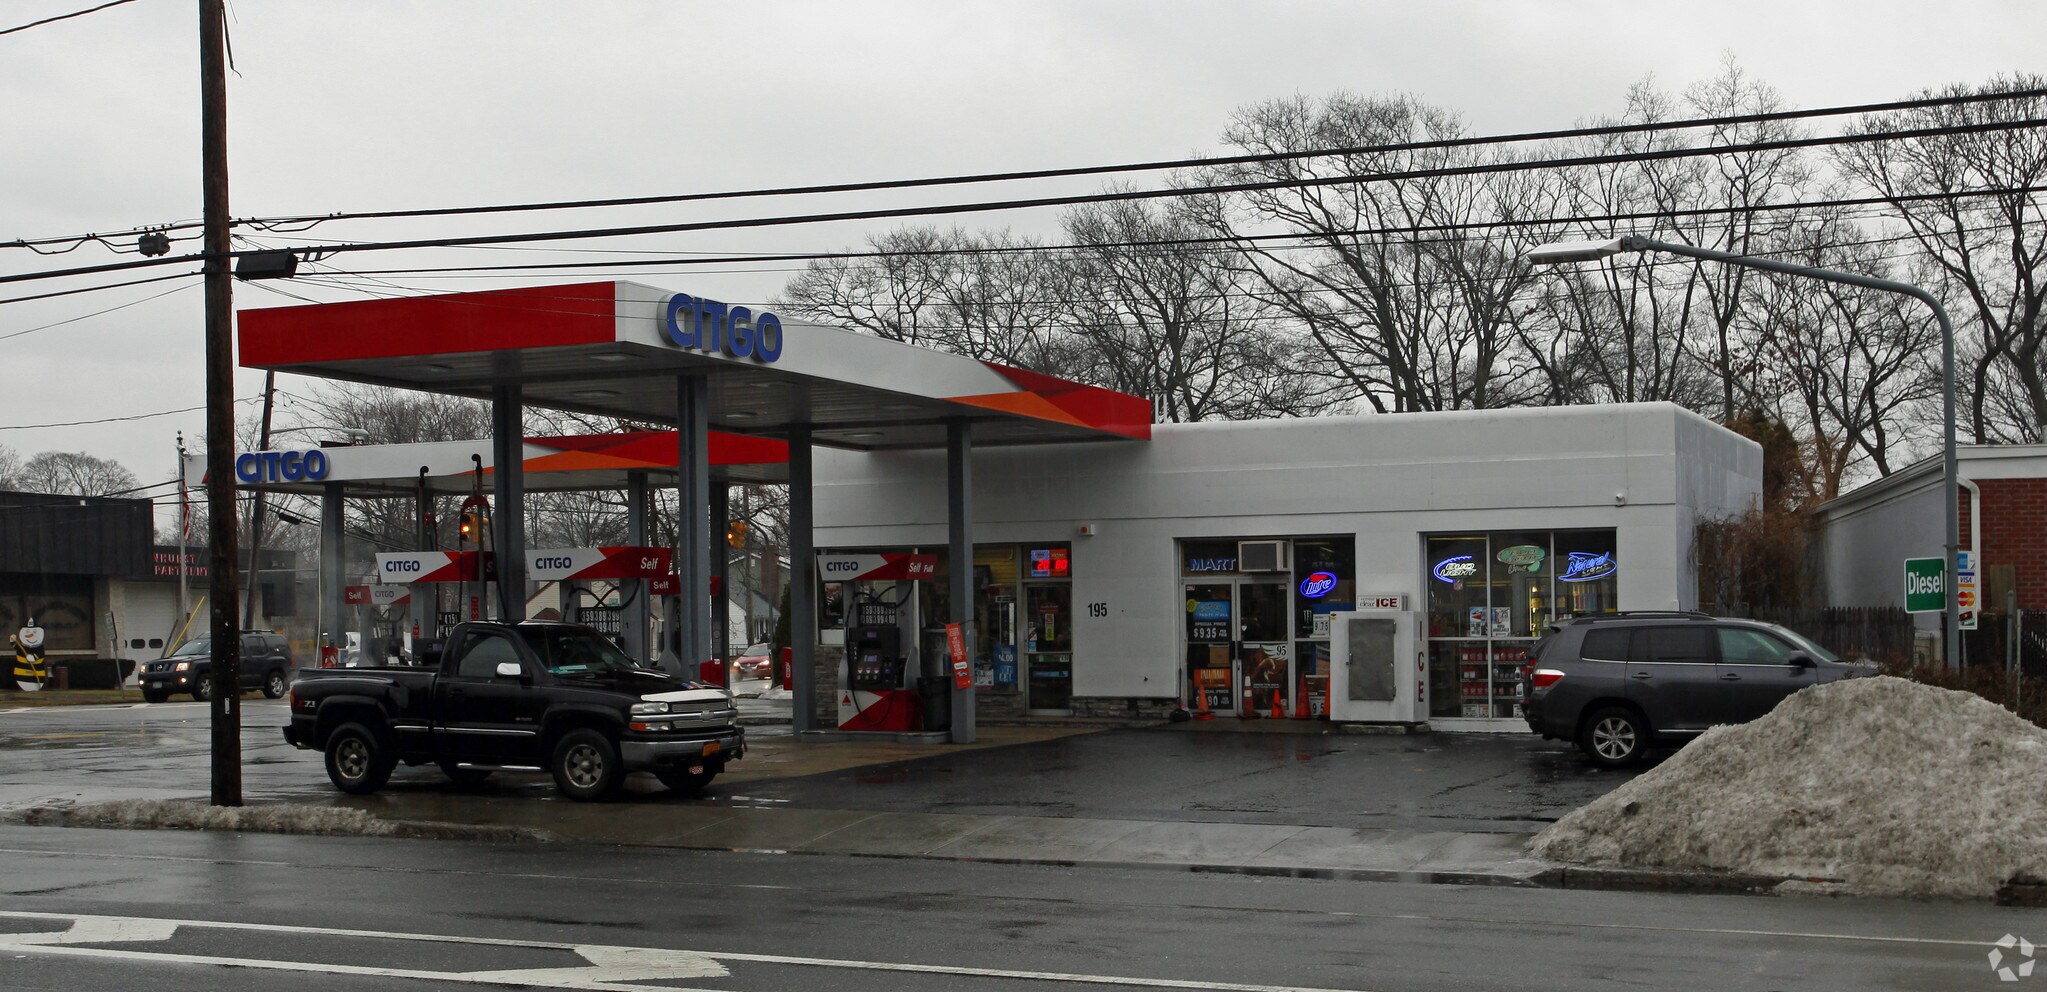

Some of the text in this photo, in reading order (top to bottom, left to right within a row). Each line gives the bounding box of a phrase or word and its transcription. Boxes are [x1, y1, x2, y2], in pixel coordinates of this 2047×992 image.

[665, 292, 783, 363] CITGO
[236, 450, 326, 482] CITGO
[385, 560, 421, 573] CITGO
[535, 556, 572, 570] CITGO
[640, 556, 659, 571] Self
[826, 561, 859, 572] CITGO
[908, 562, 922, 573] Self
[1037, 559, 1050, 571] 20
[1055, 559, 1068, 570] 80
[1190, 557, 1236, 572] MART
[653, 581, 669, 590] Self
[1908, 570, 1943, 595] Diesel
[348, 591, 362, 600] Self
[374, 590, 395, 599] CITGO
[1376, 598, 1398, 609] ICE
[1087, 602, 1108, 618] 195
[1276, 645, 1287, 656] 95
[1417, 620, 1425, 703] ICE
